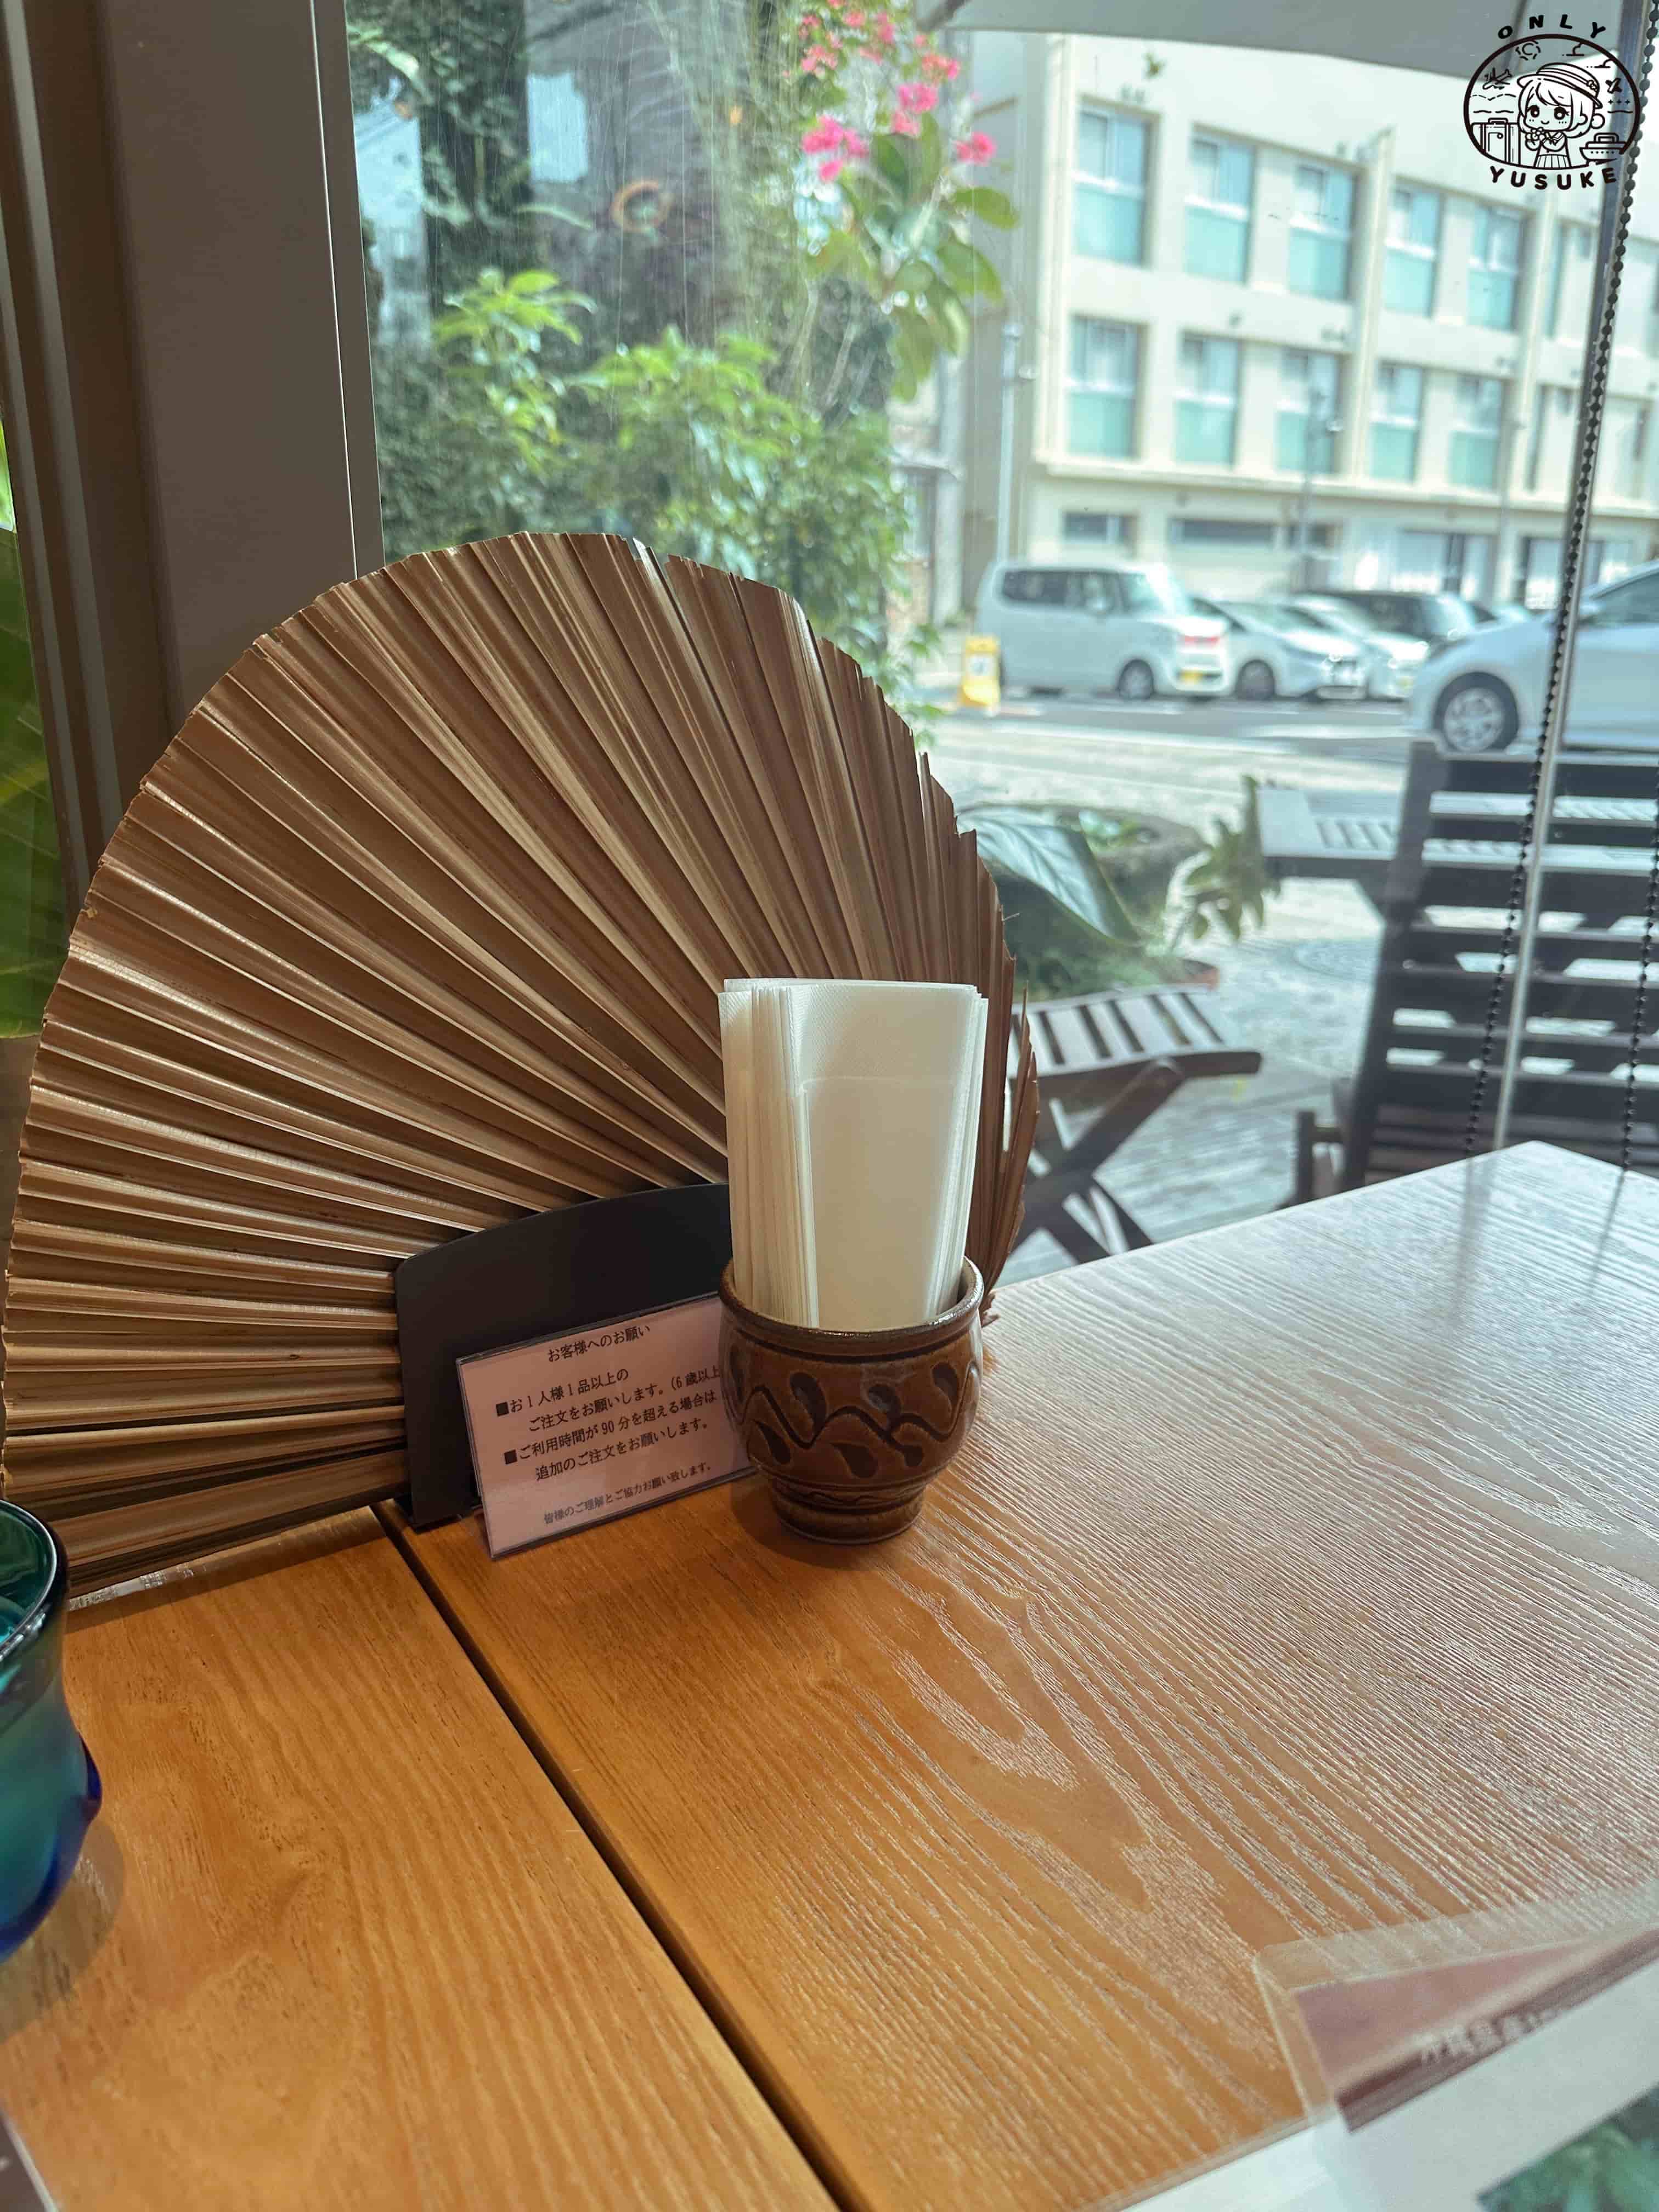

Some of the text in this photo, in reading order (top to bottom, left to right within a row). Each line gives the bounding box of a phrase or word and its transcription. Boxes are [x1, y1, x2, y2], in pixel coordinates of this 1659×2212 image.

[548, 1324, 650, 1362] お客様へのお願い
[535, 1417, 707, 1481] 追加のご注文をお願いします。
